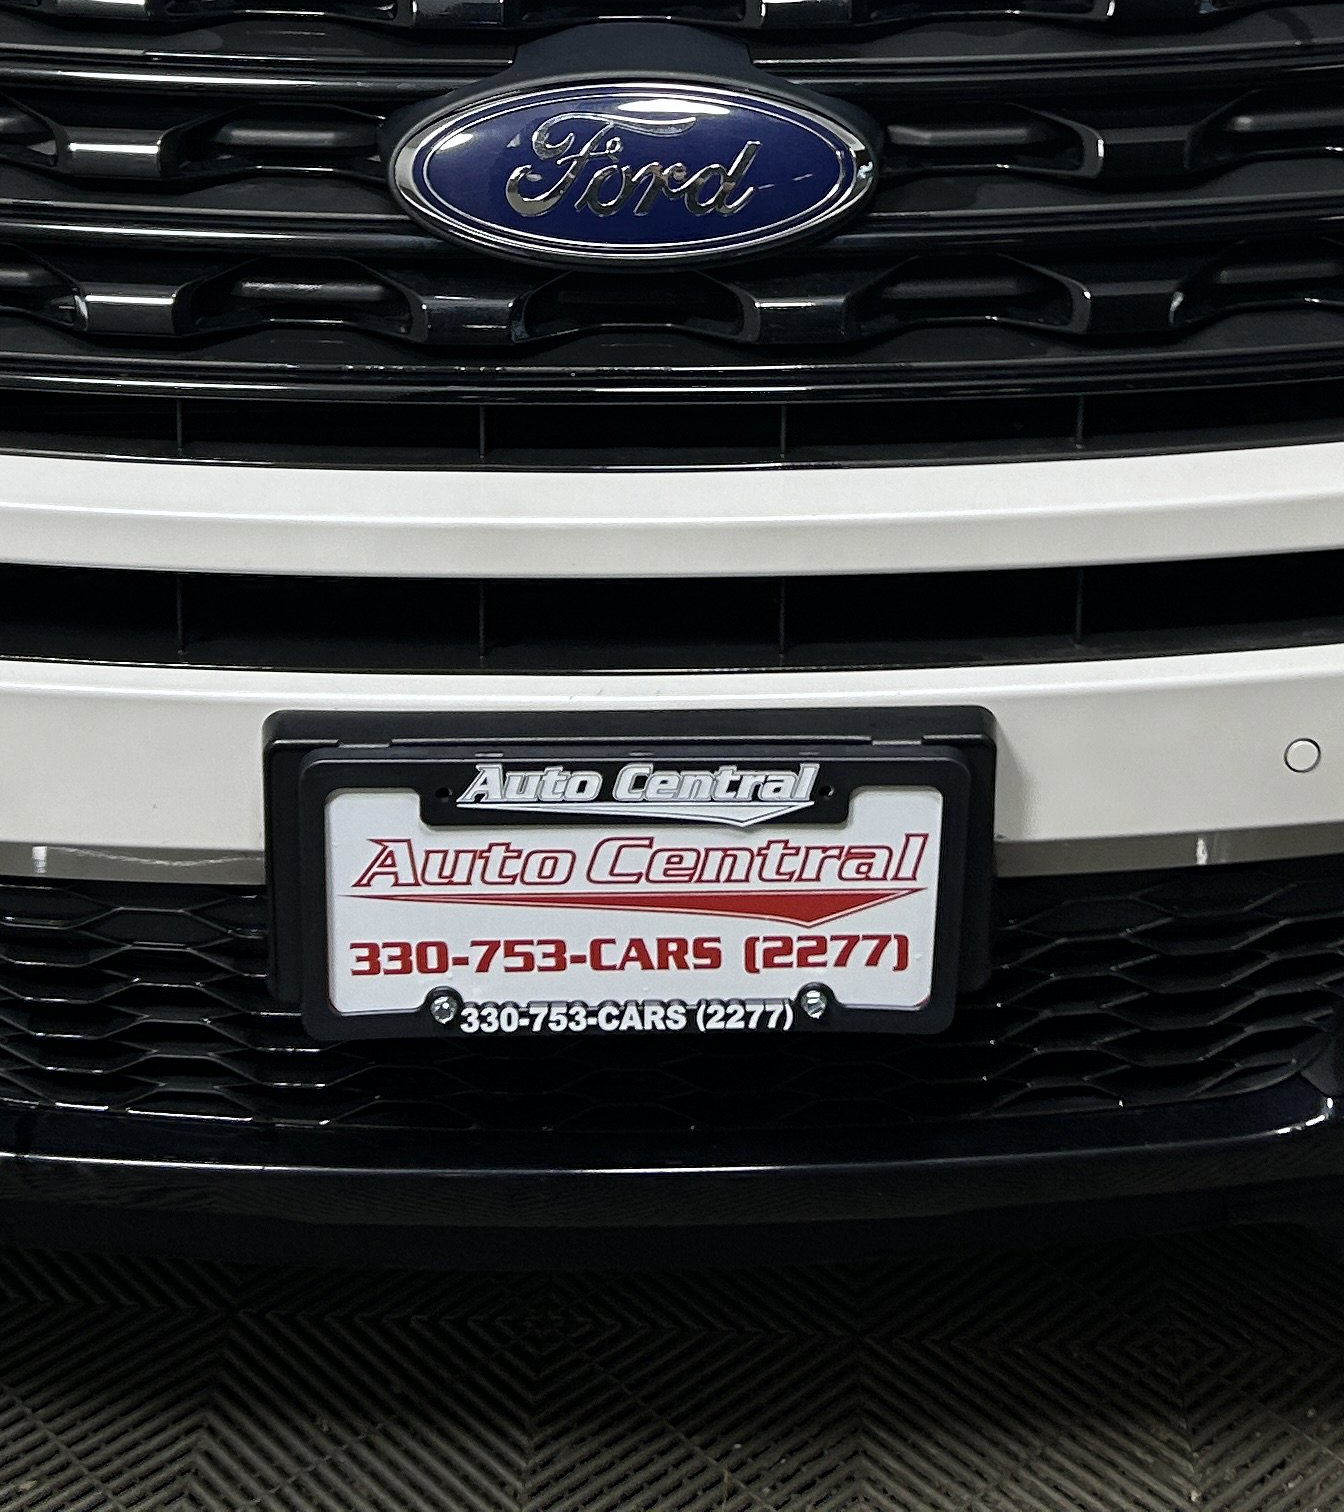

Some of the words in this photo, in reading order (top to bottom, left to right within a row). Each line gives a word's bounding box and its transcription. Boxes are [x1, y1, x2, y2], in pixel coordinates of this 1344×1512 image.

[504, 110, 761, 218] Ford
[457, 763, 600, 804] Auto
[613, 762, 821, 803] Central
[352, 837, 577, 887] Auto
[587, 833, 930, 885] Central
[350, 937, 724, 976] 330-753-CARS
[744, 934, 910, 975] (2277)
[460, 1002, 687, 1034] 330-753-CARS
[696, 1002, 794, 1033] (2277)
